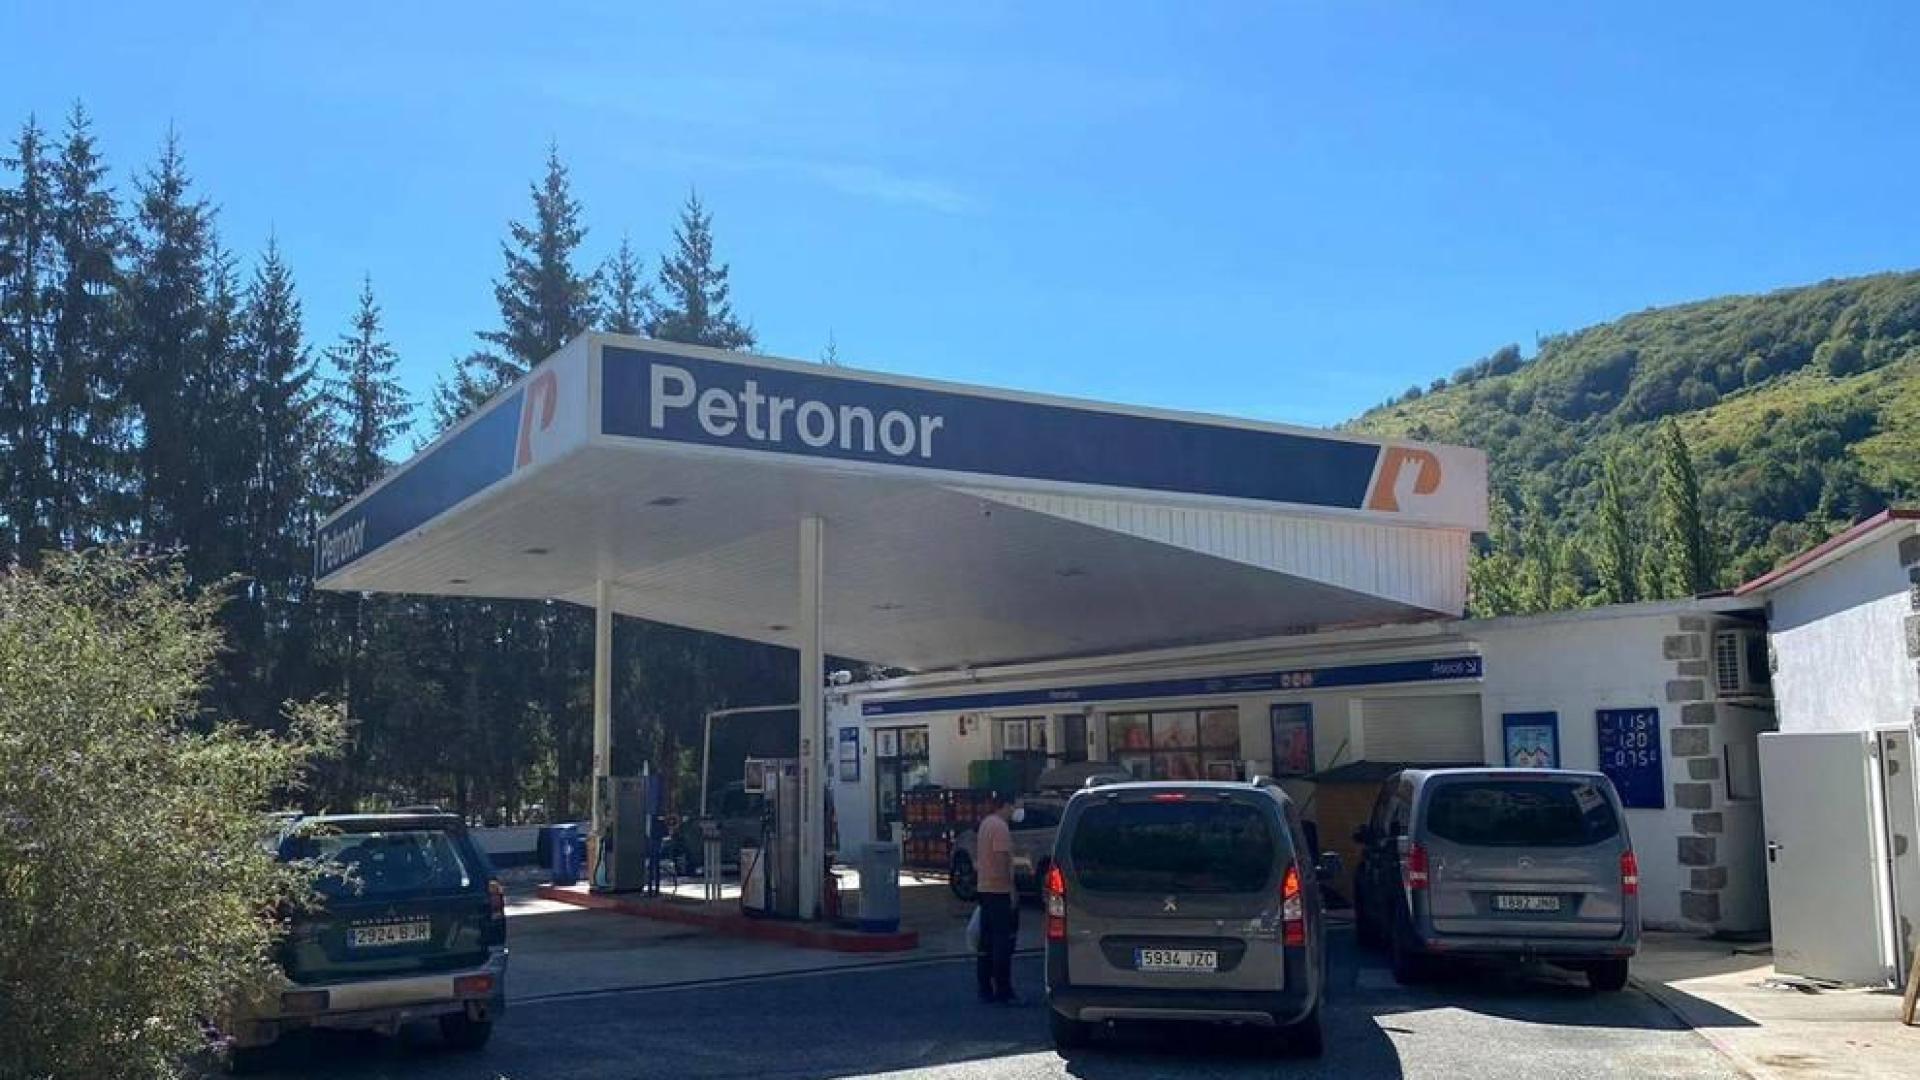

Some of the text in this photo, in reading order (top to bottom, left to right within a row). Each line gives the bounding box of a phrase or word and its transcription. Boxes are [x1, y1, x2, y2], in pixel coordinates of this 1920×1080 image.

[651, 363, 944, 458] Petronor
[321, 516, 367, 572] Petronor
[358, 927, 395, 943] 2924
[1143, 951, 1213, 966] 5934 JZC
